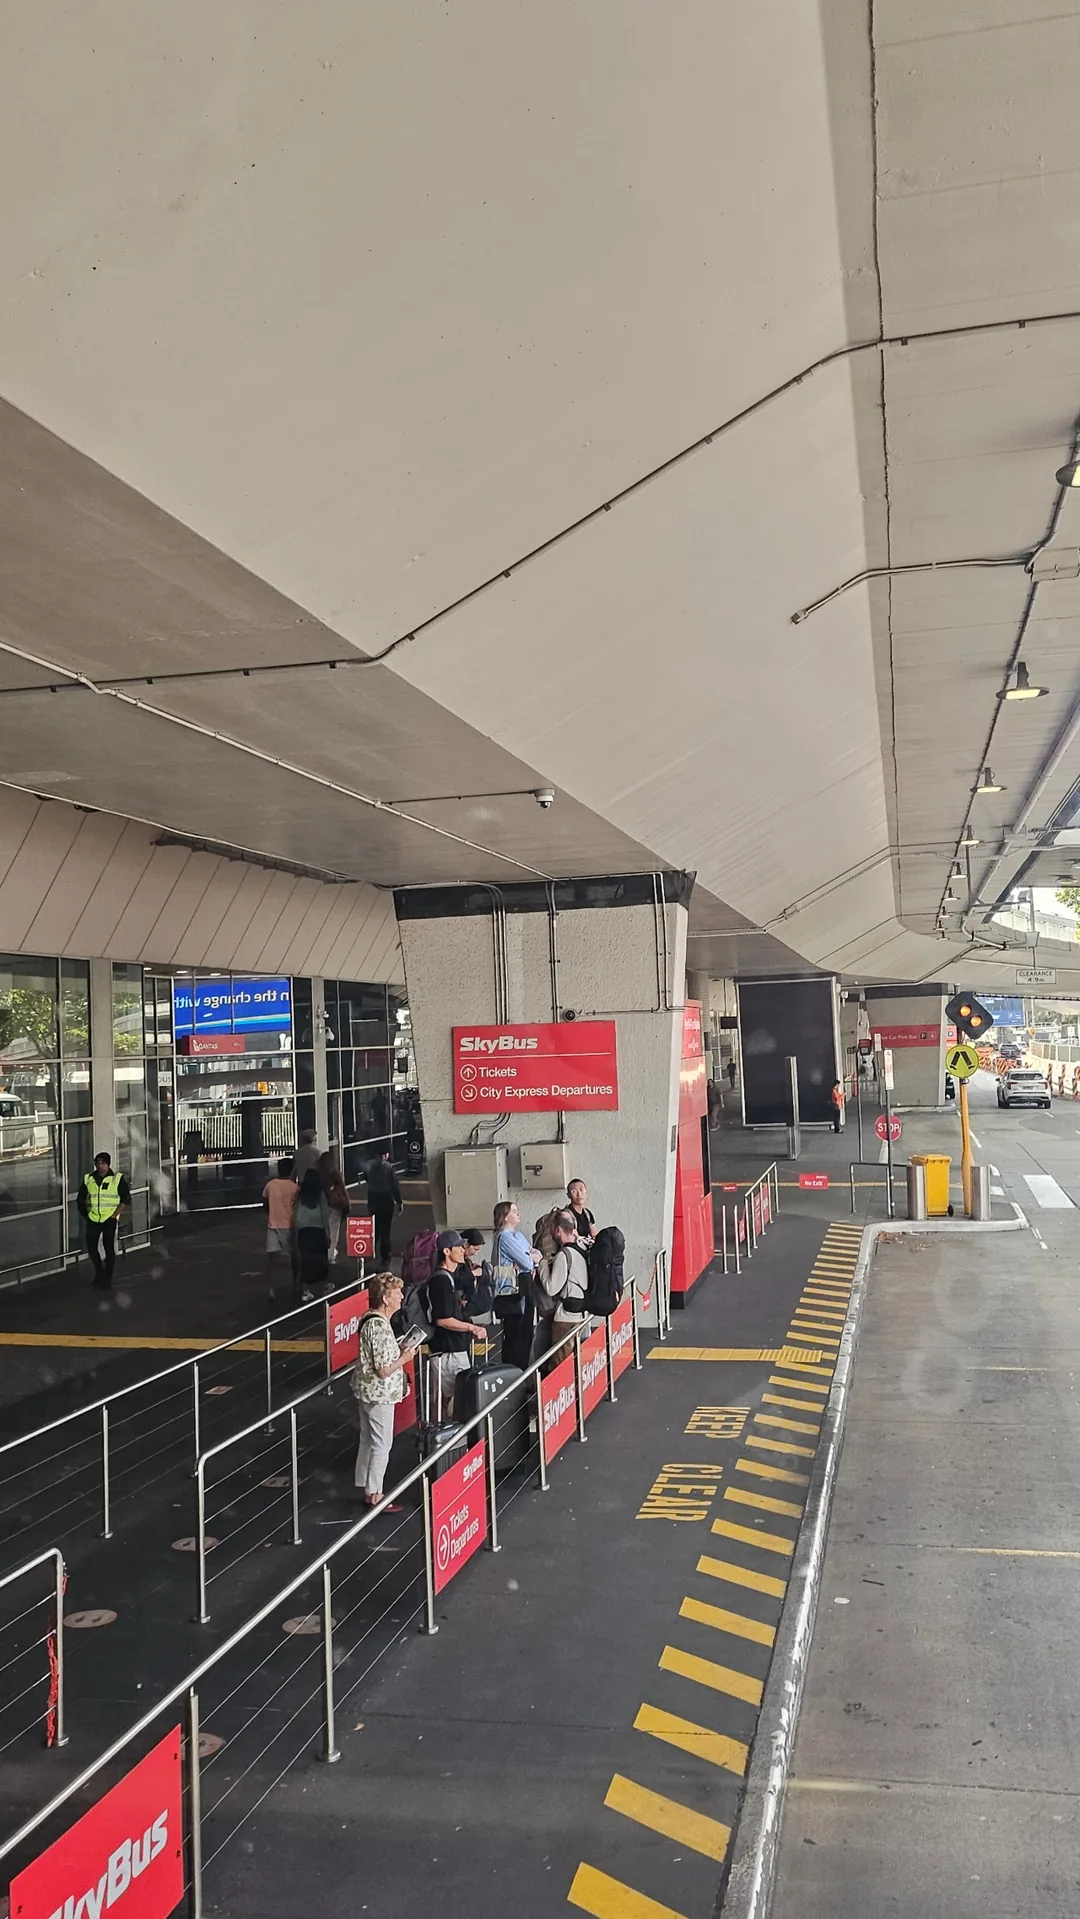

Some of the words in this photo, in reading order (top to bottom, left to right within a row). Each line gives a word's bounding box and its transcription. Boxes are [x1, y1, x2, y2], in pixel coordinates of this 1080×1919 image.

[460, 1035, 538, 1054] SkyBus
[478, 1066, 517, 1078] Tickets
[480, 1086, 502, 1099] City
[505, 1085, 549, 1099] Express
[551, 1084, 613, 1098] Departures
[877, 1122, 900, 1133] STOP
[611, 1320, 633, 1357] SkyBus
[582, 1348, 607, 1392] SkyBus
[543, 1382, 575, 1433] SkyBus
[684, 1406, 751, 1439] KEEP
[462, 1453, 483, 1483] SkyBus
[635, 1463, 724, 1522] CLEAR
[449, 1504, 469, 1534] Tickets
[450, 1517, 479, 1560] Departures
[48, 1808, 169, 1919] kyBus
